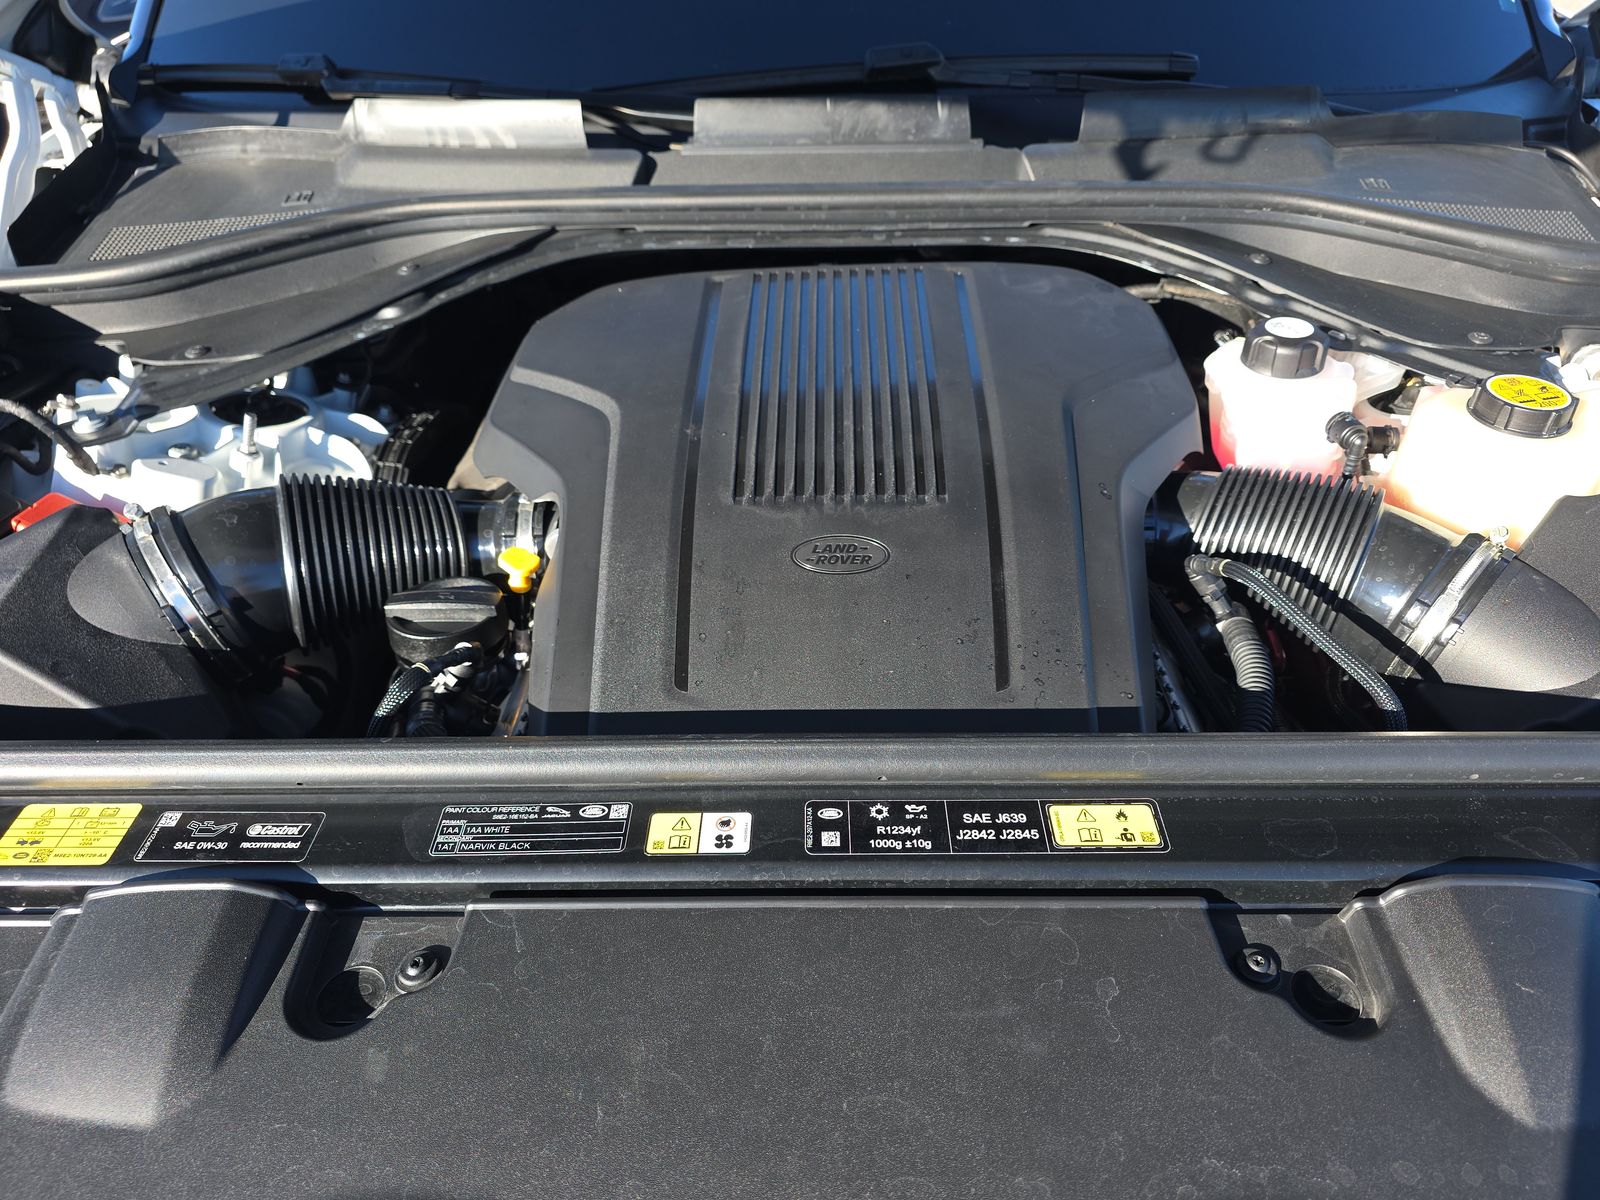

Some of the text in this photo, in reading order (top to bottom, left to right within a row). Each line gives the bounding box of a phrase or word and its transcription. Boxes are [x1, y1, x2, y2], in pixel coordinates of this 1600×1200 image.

[962, 813, 1027, 823] SAE J639
[261, 825, 301, 836] Castrol
[483, 826, 511, 834] WHITE
[876, 826, 922, 836] R1234yf
[956, 829, 1040, 840] J2842 J2845
[173, 841, 229, 850] SAE 0W-30
[239, 840, 302, 850] recommended
[437, 843, 455, 851] 1AT
[460, 842, 531, 851] NARVIK BLACK
[869, 839, 932, 850] 1000g ±10g
